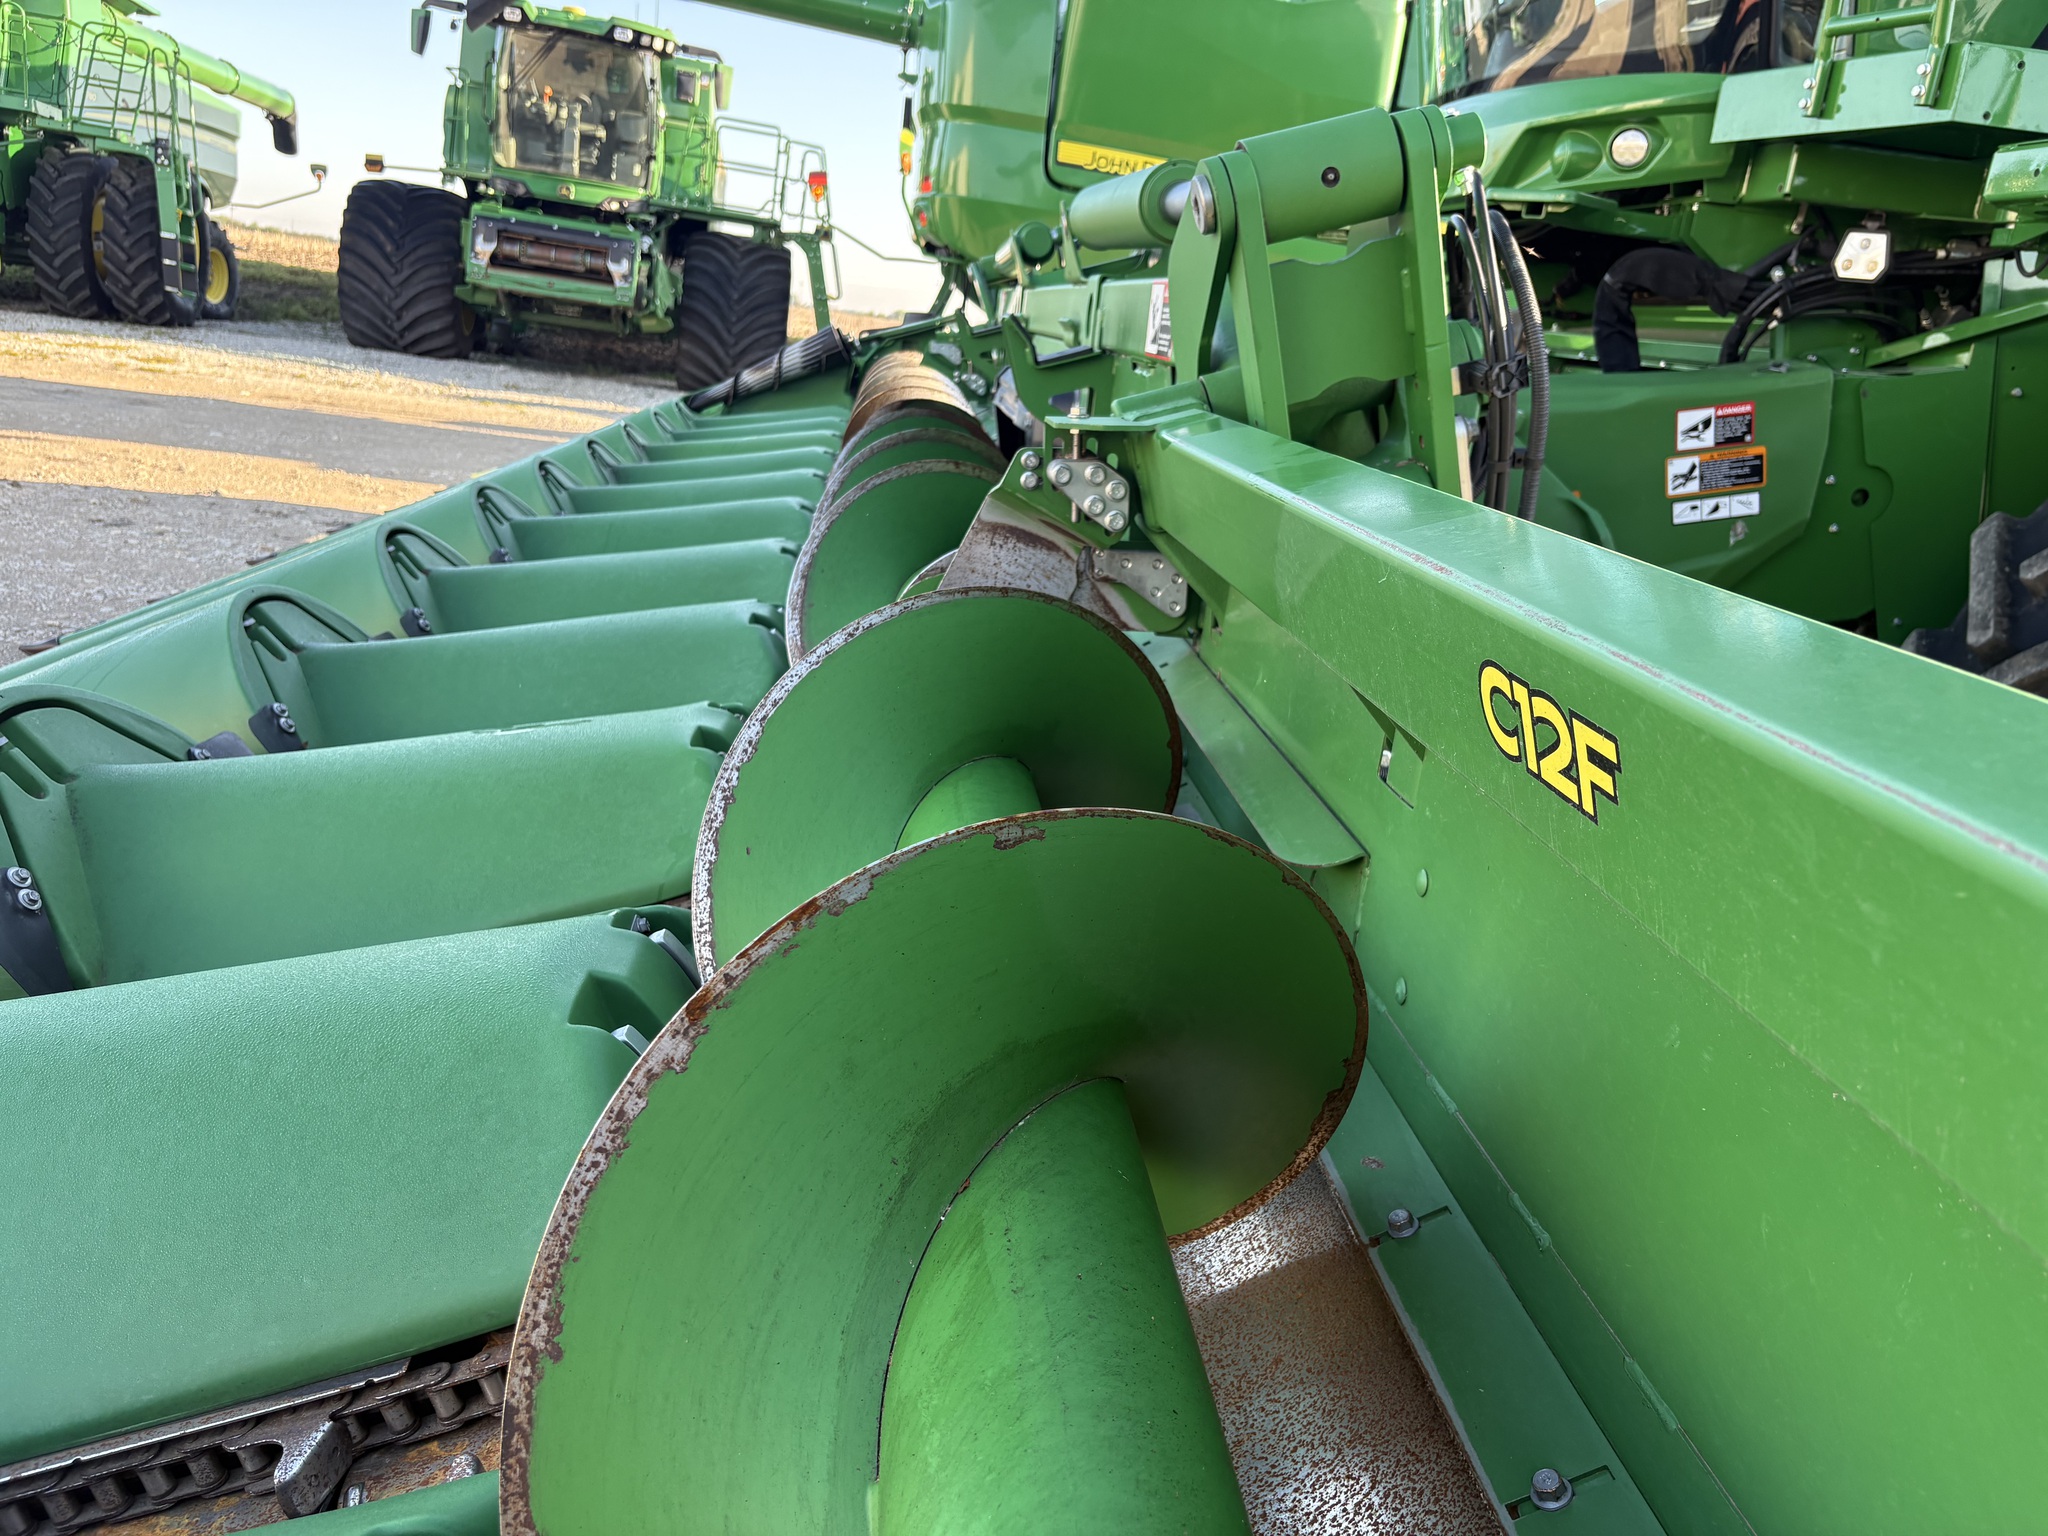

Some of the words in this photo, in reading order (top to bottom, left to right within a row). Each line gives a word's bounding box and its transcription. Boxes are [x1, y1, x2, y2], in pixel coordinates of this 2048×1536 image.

[1083, 150, 1136, 173] JOHN
[1722, 404, 1752, 415] DANGER
[1479, 659, 1622, 826] C12F
